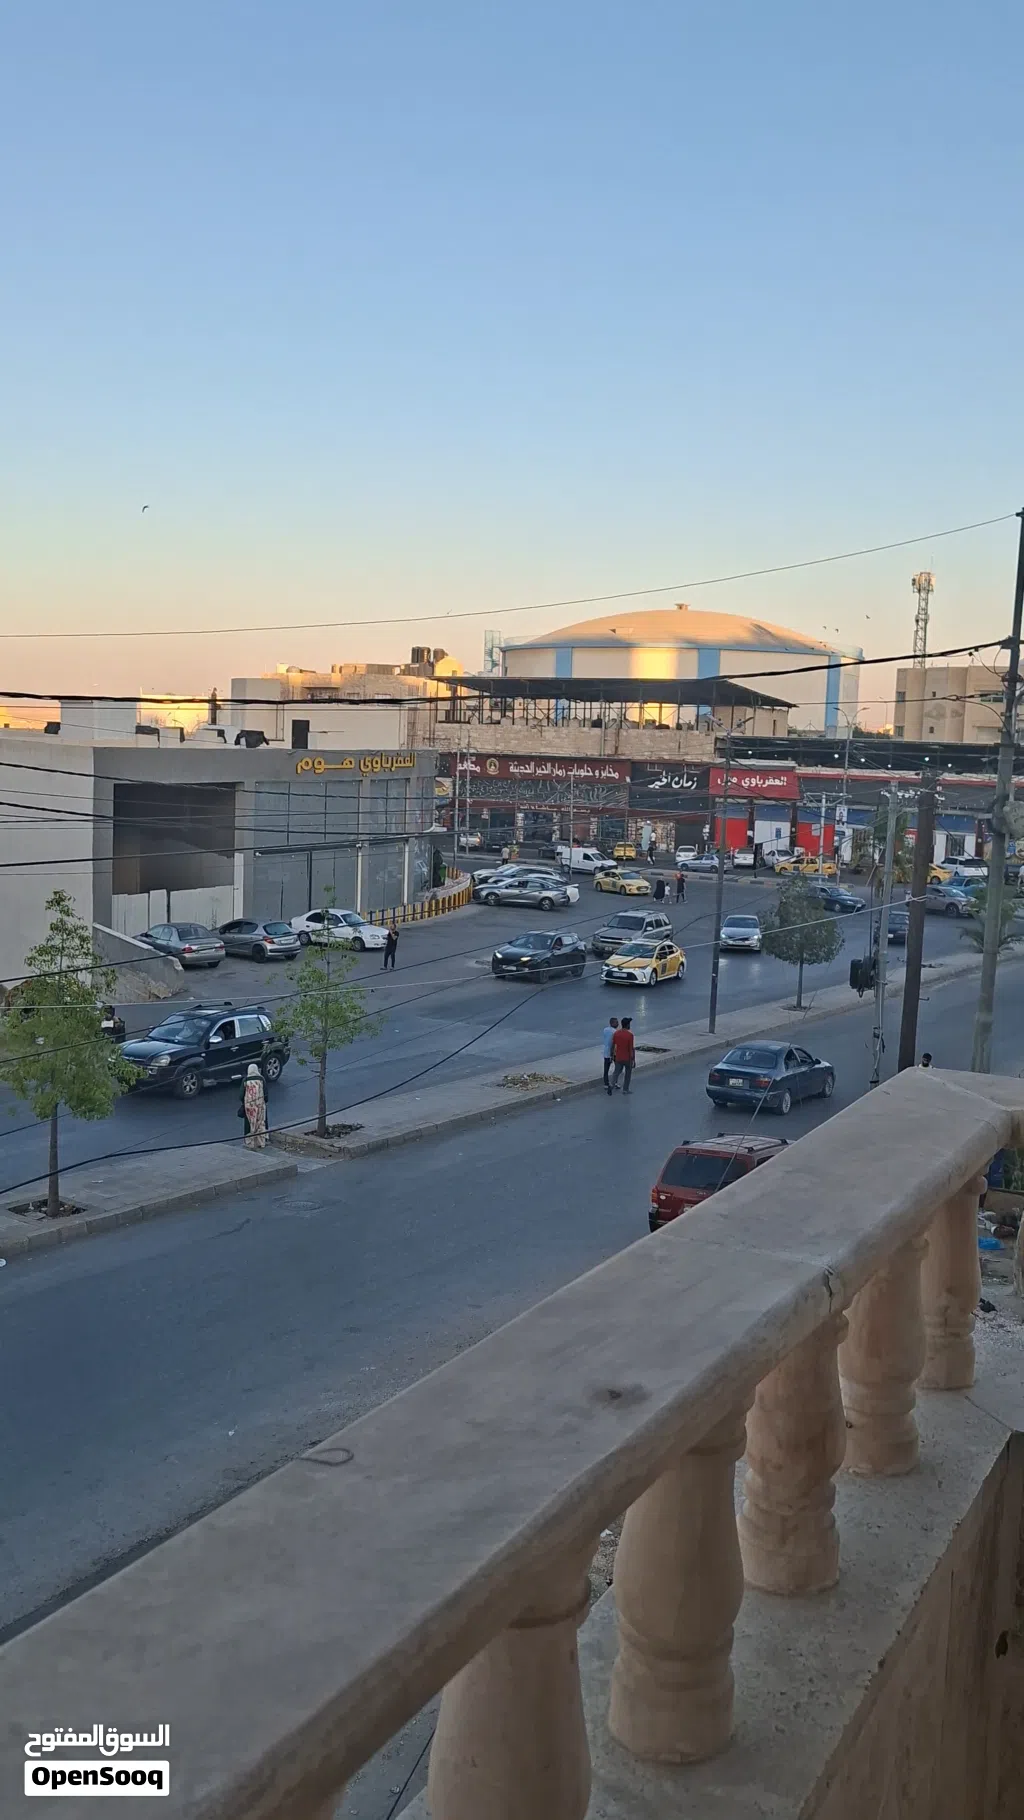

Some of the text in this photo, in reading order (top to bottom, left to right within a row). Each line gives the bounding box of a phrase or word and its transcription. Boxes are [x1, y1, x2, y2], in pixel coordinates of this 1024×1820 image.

[296, 752, 416, 777] العقرباوي هوم
[508, 760, 620, 780] مخابز و حلويات زمان الخير الحديثة
[647, 769, 698, 789] زمان الخير
[741, 775, 787, 789] العقرباوي
